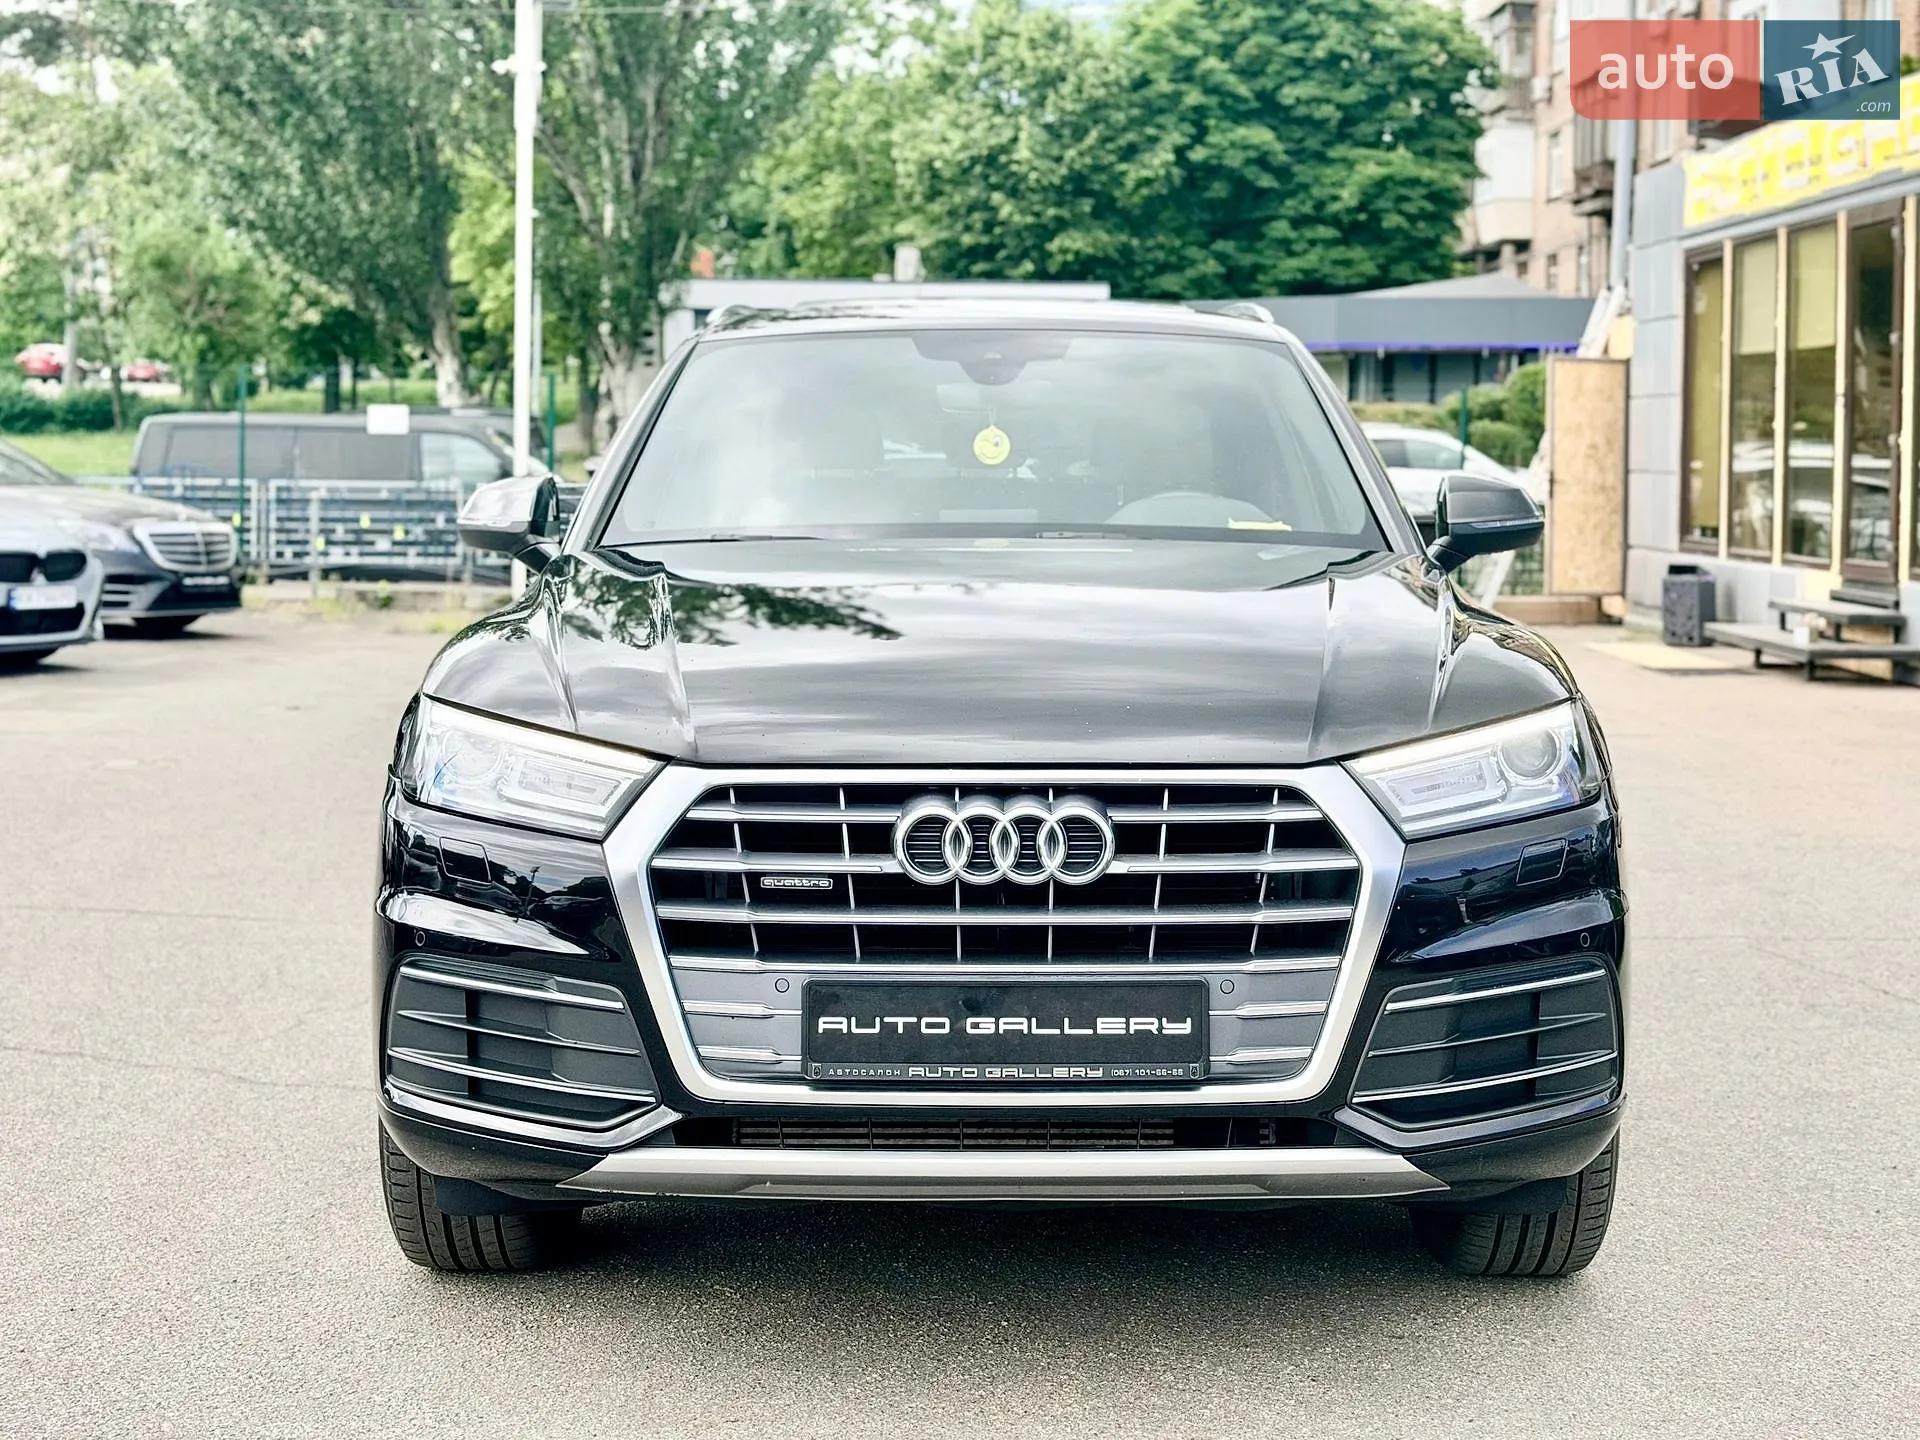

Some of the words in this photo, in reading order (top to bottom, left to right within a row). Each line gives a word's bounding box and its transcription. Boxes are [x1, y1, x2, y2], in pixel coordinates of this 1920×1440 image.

[763, 879, 830, 887] quattro
[817, 1016, 951, 1034] AUTO
[965, 1016, 1192, 1035] GALLERY
[828, 1068, 901, 1077] АВТОСАЛОН
[908, 1066, 978, 1078] AUTO
[985, 1066, 1103, 1078] GALLERY
